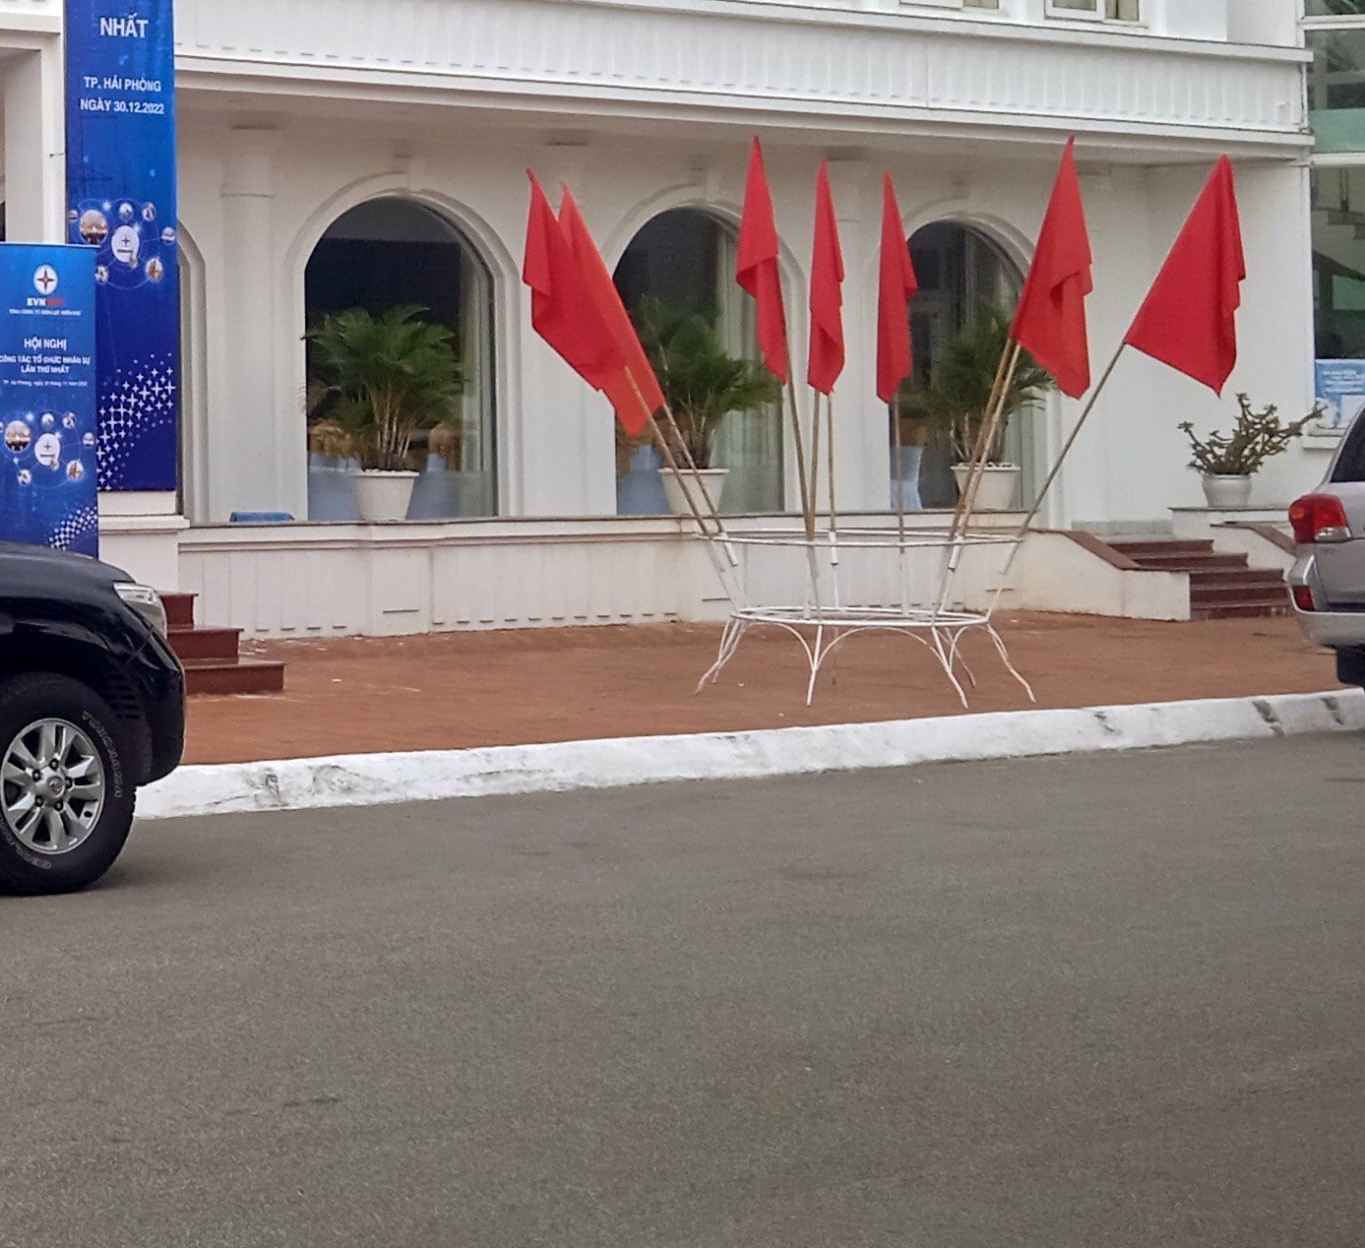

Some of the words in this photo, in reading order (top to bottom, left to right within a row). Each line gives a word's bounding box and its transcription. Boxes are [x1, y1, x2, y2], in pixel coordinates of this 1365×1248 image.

[101, 13, 148, 37] NHẤT
[84, 77, 101, 89] TP.
[81, 97, 111, 111] NGÀY
